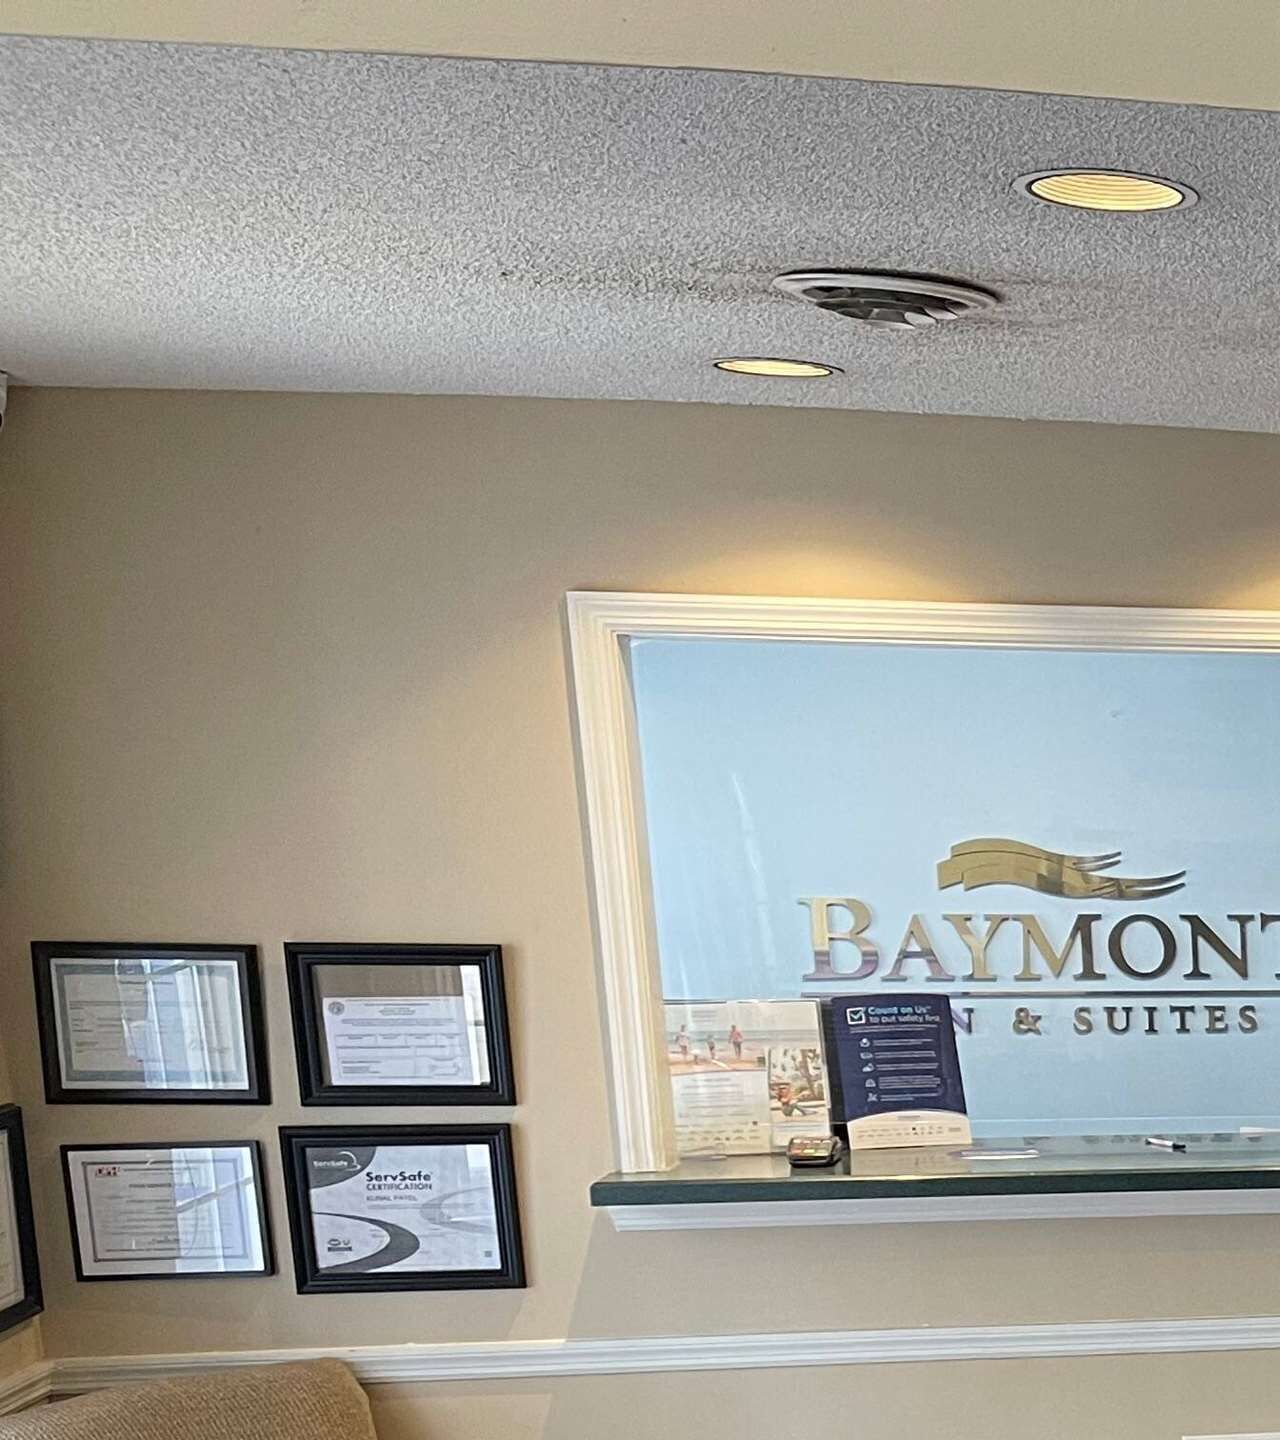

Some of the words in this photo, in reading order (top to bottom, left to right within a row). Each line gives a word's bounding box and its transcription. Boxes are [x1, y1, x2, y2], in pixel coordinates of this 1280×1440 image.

[868, 1006, 898, 1015] Count
[900, 1006, 913, 1014] on
[869, 1015, 880, 1023] to
[1012, 1006, 1043, 1035] &
[1073, 1004, 1259, 1035] SUITES
[365, 1170, 432, 1182] ServSafe
[366, 1182, 433, 1191] CERTIFICATION
